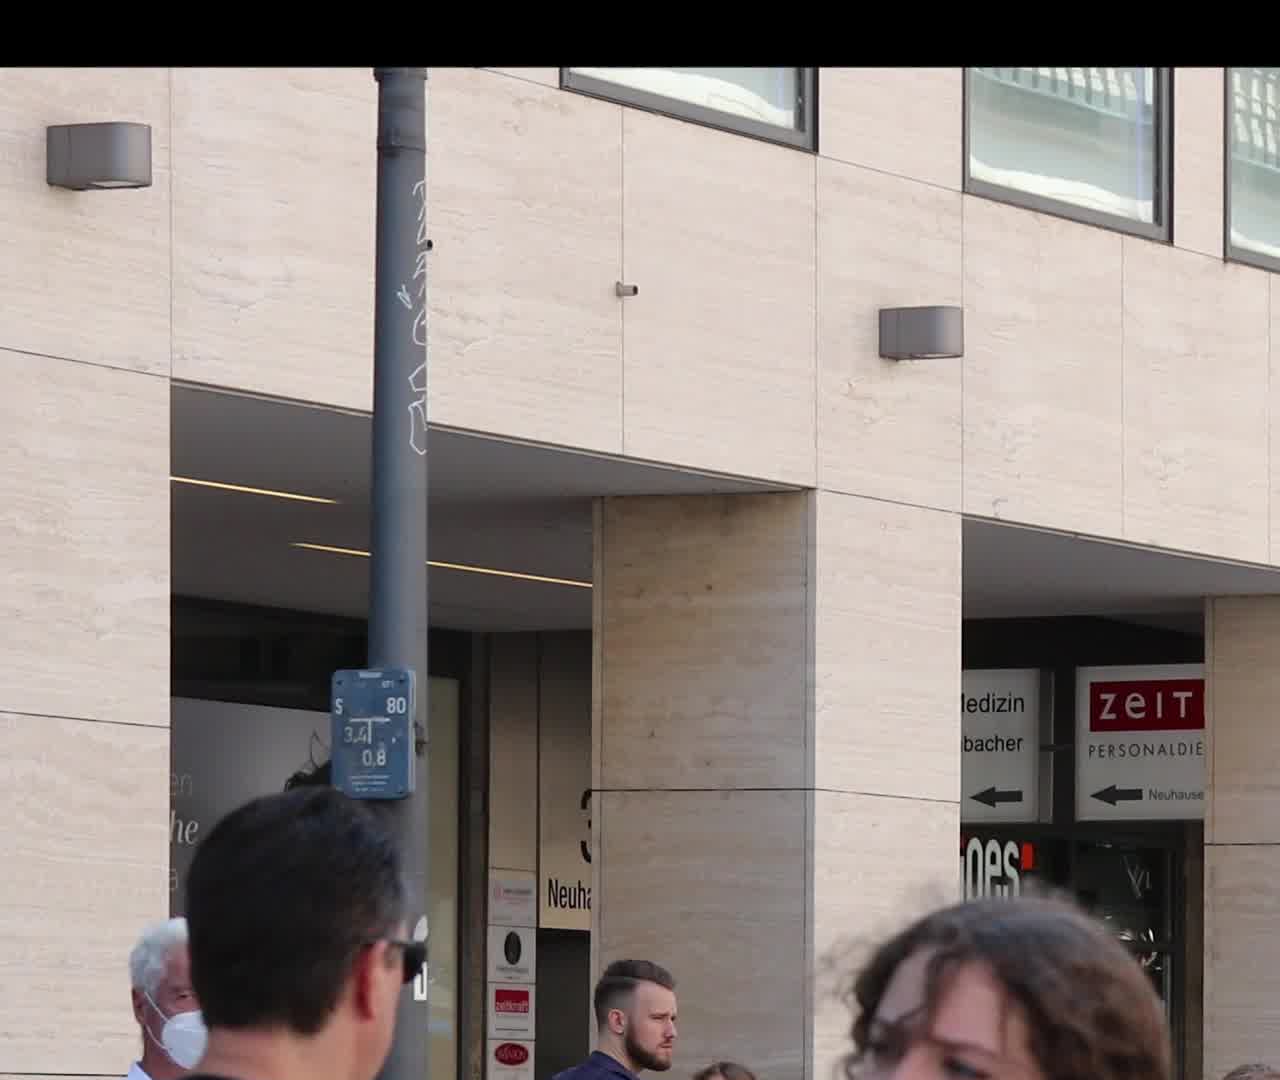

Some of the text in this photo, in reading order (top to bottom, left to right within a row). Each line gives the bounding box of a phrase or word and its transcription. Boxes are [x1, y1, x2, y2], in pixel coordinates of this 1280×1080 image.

[386, 696, 407, 714] 80
[961, 692, 1025, 713] edizin
[362, 748, 386, 766] 0,8
